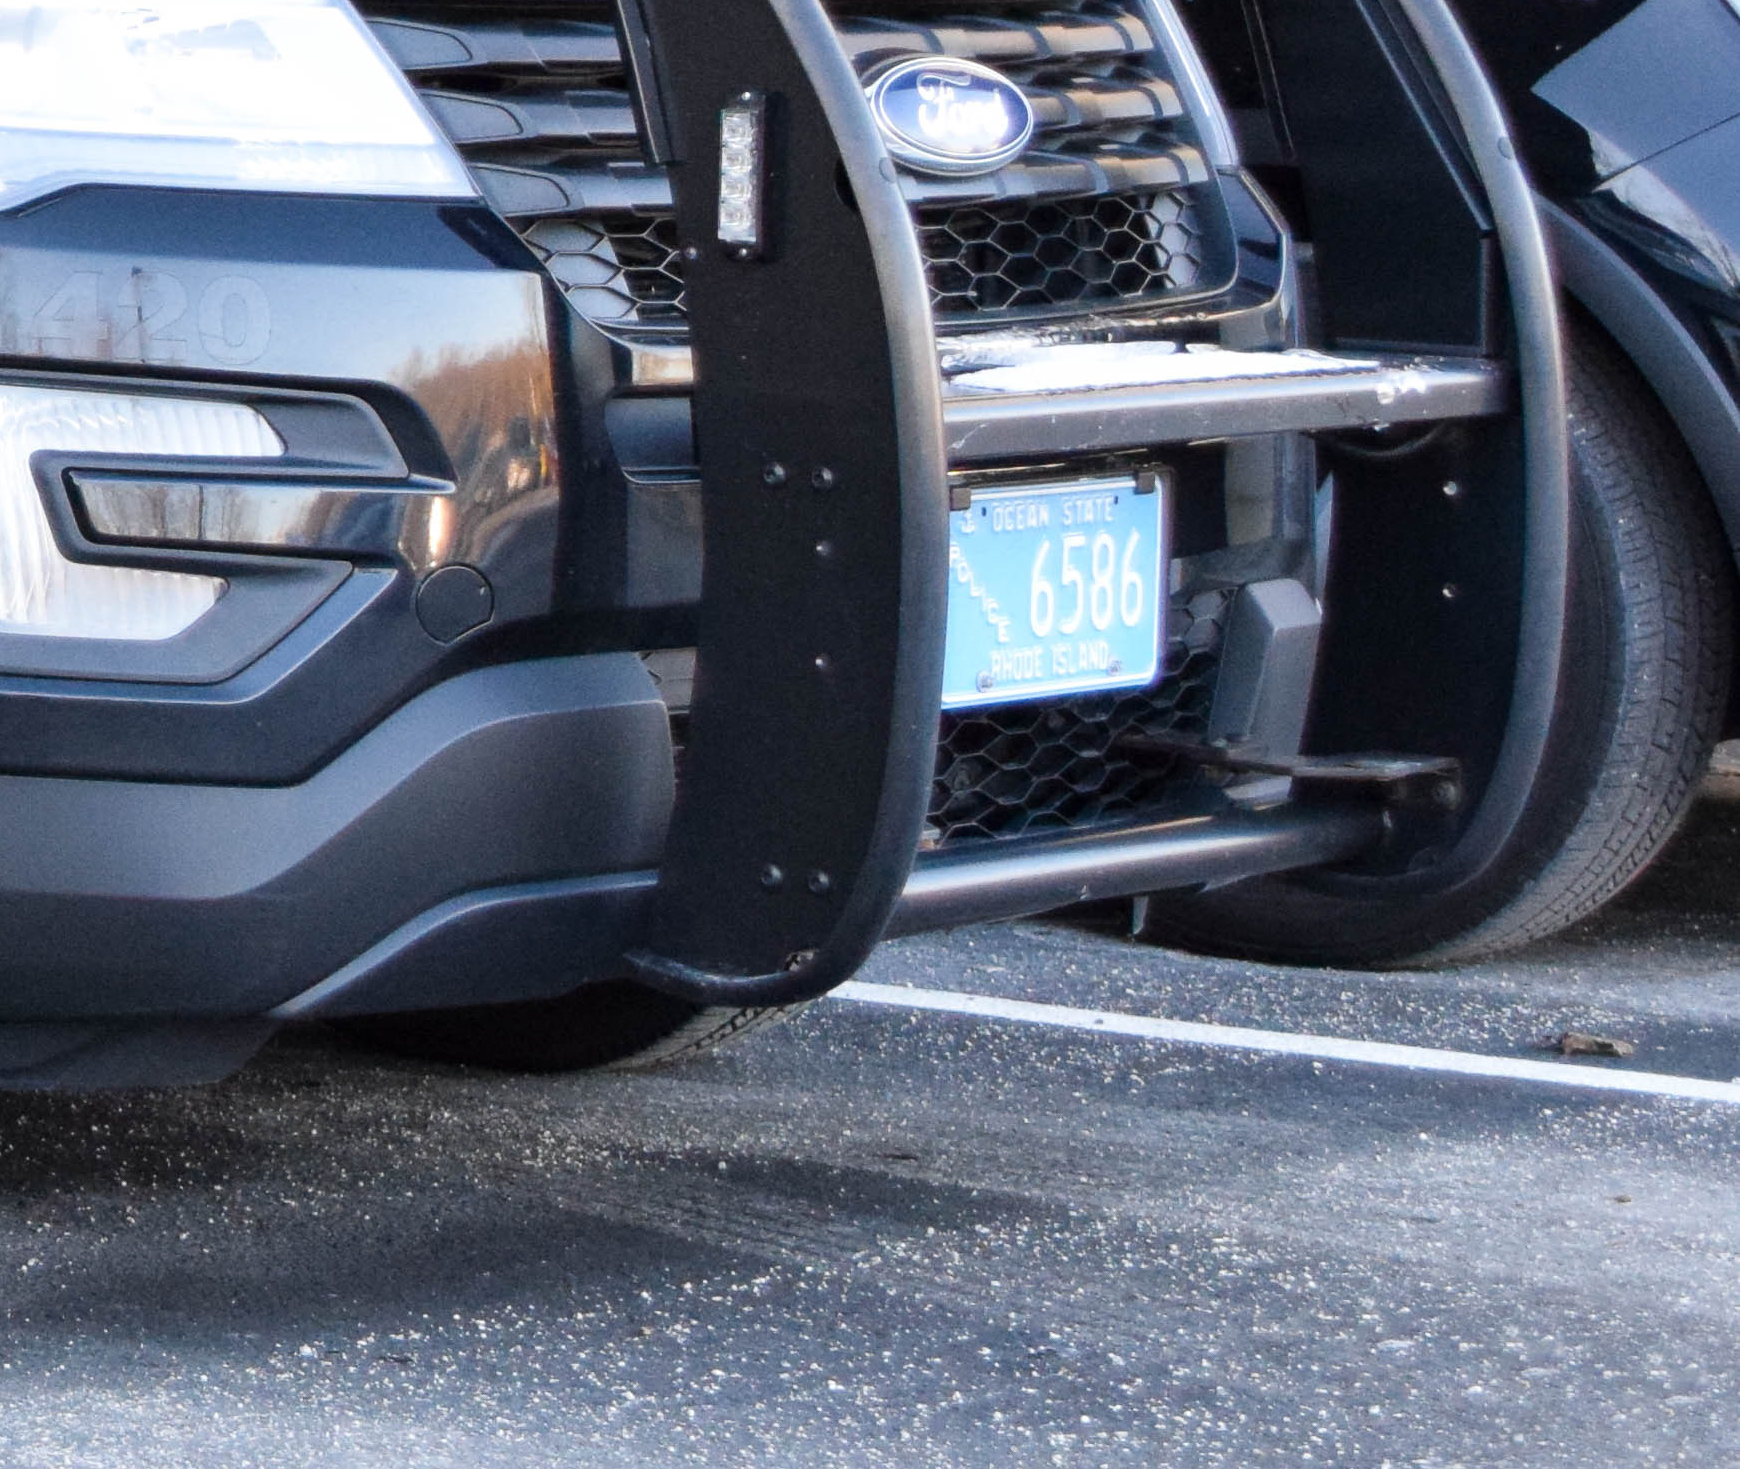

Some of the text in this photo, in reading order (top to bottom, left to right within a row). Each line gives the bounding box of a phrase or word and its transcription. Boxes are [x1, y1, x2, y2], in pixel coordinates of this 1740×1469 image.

[916, 72, 1009, 138] Ford
[27, 269, 272, 365] 420
[992, 496, 1115, 532] OCEAN STATE
[950, 542, 1010, 643] POLICE
[1030, 528, 1143, 638] 6586
[990, 640, 1109, 681] RHODE ISLAND
